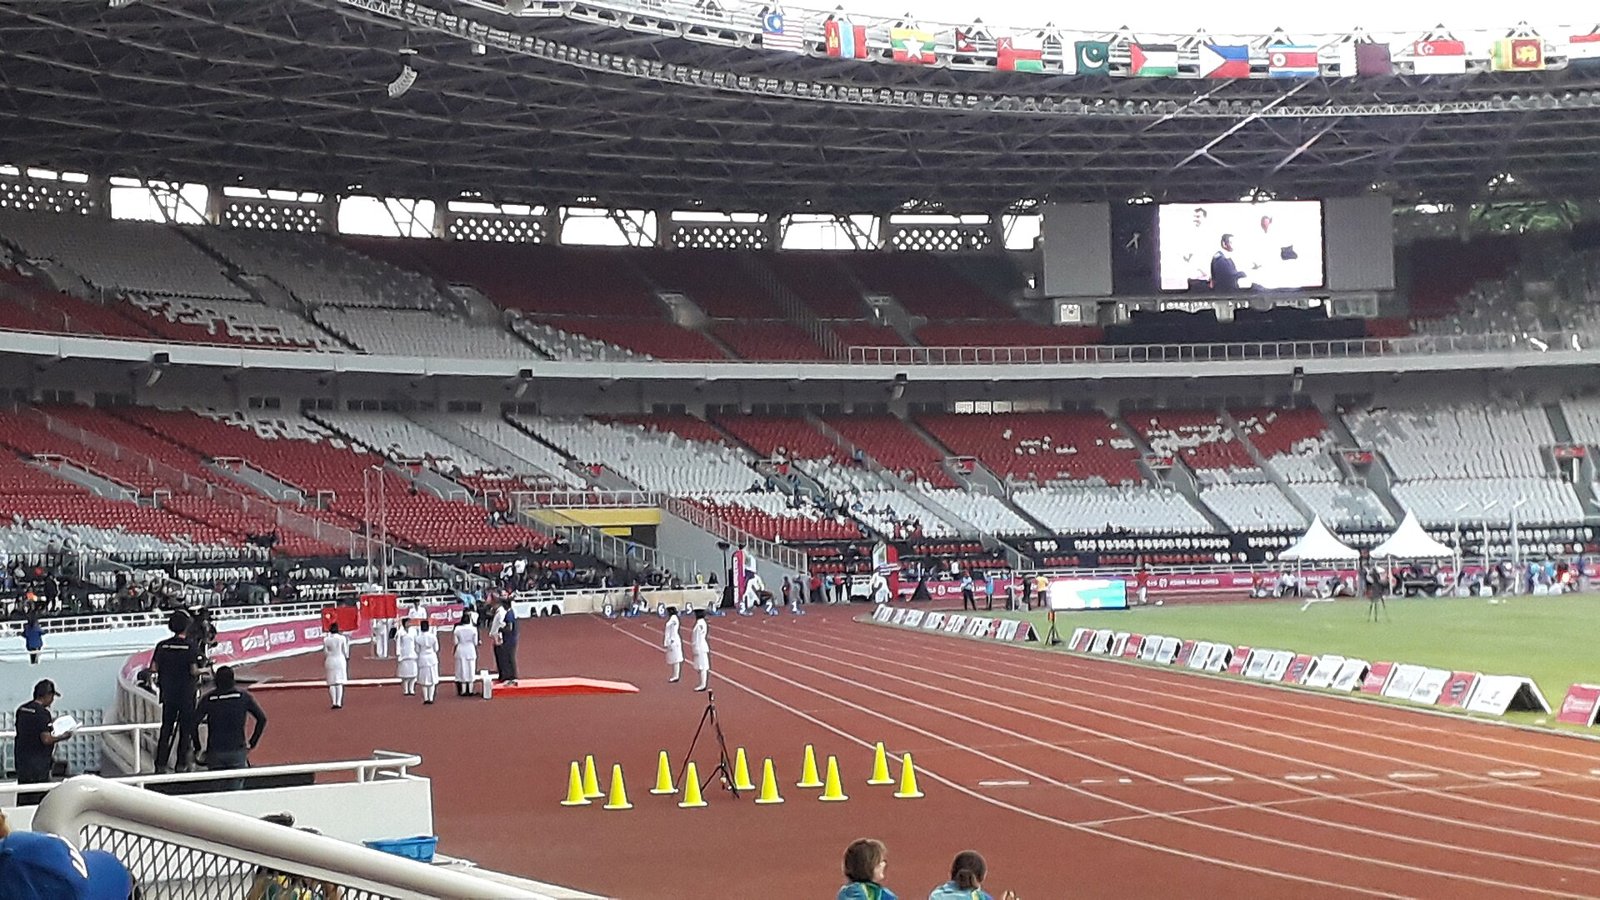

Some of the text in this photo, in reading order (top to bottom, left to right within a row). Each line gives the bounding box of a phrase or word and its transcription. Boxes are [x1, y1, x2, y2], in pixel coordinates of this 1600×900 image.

[604, 605, 612, 616] 8
[632, 604, 639, 615] 7
[658, 604, 665, 615] 6
[686, 603, 693, 614] 5
[739, 602, 746, 613] 3
[792, 600, 798, 612] 1
